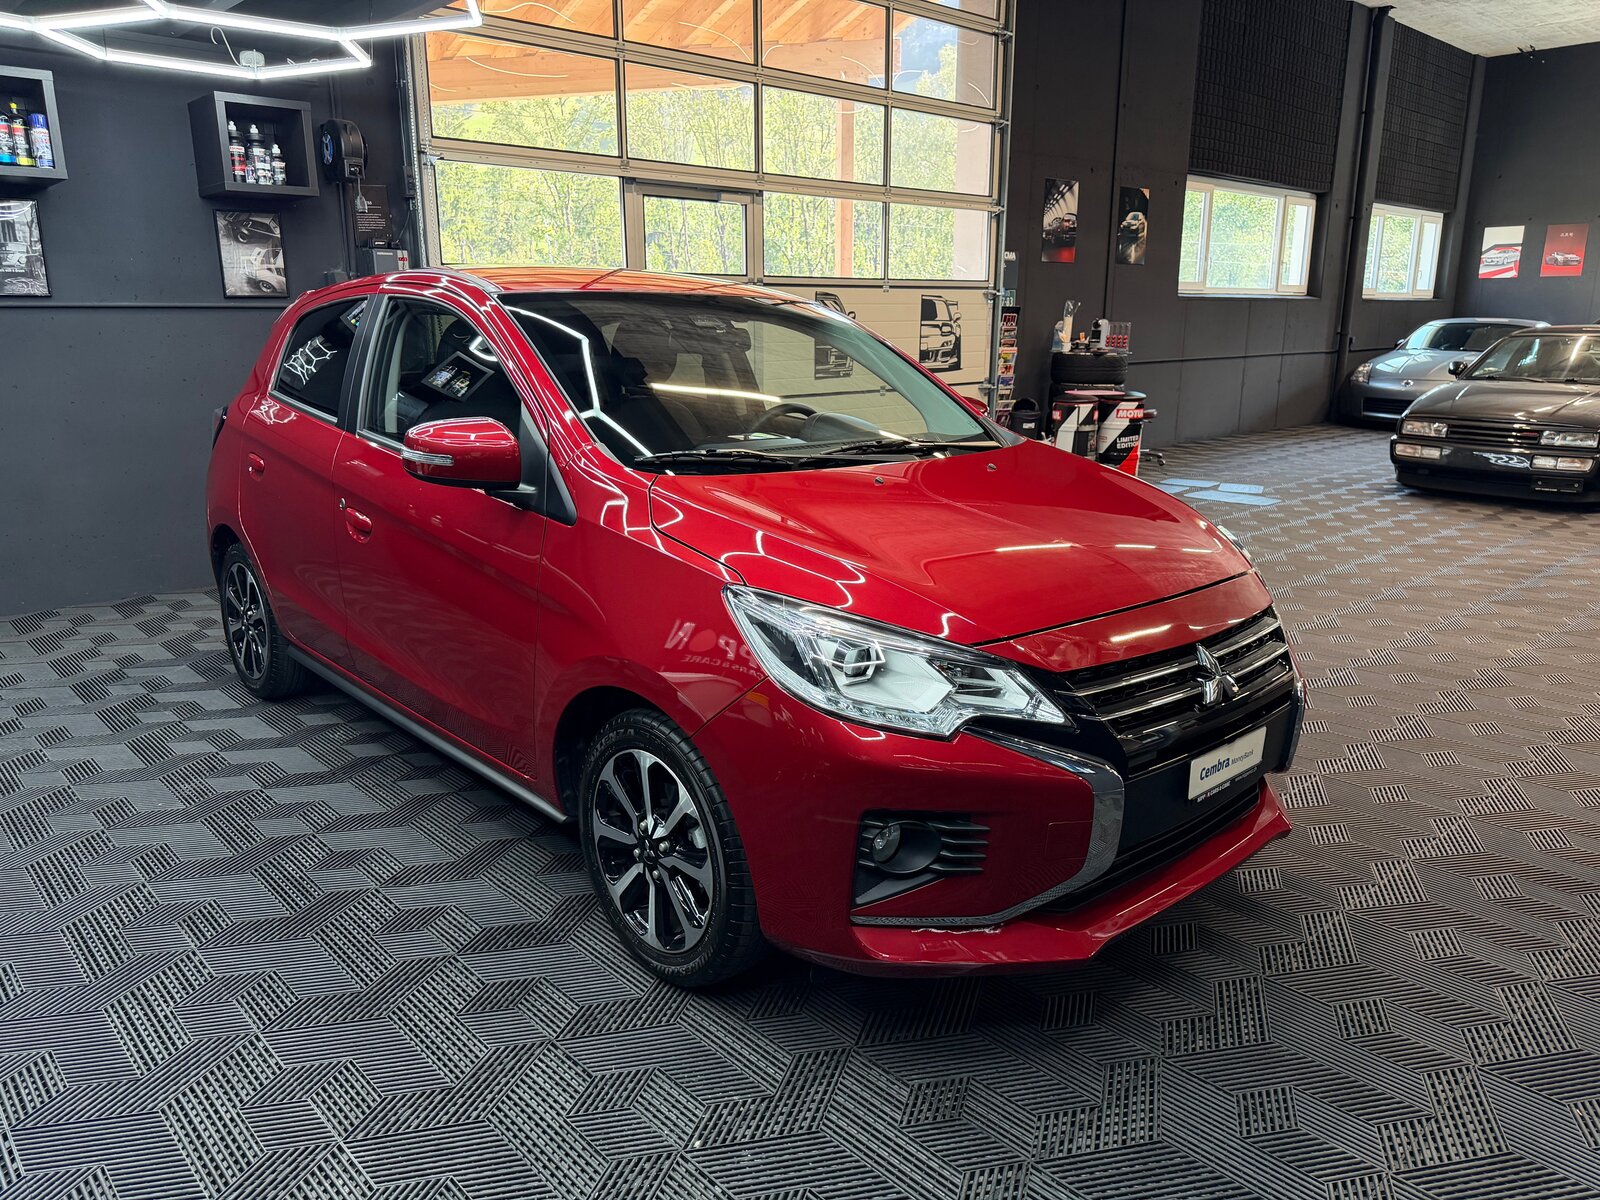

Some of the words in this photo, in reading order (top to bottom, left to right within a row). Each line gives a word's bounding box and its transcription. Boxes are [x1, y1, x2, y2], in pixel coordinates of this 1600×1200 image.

[1117, 409, 1144, 418] MOTU
[1116, 435, 1139, 443] LIMITED
[1200, 758, 1230, 780] Cembra
